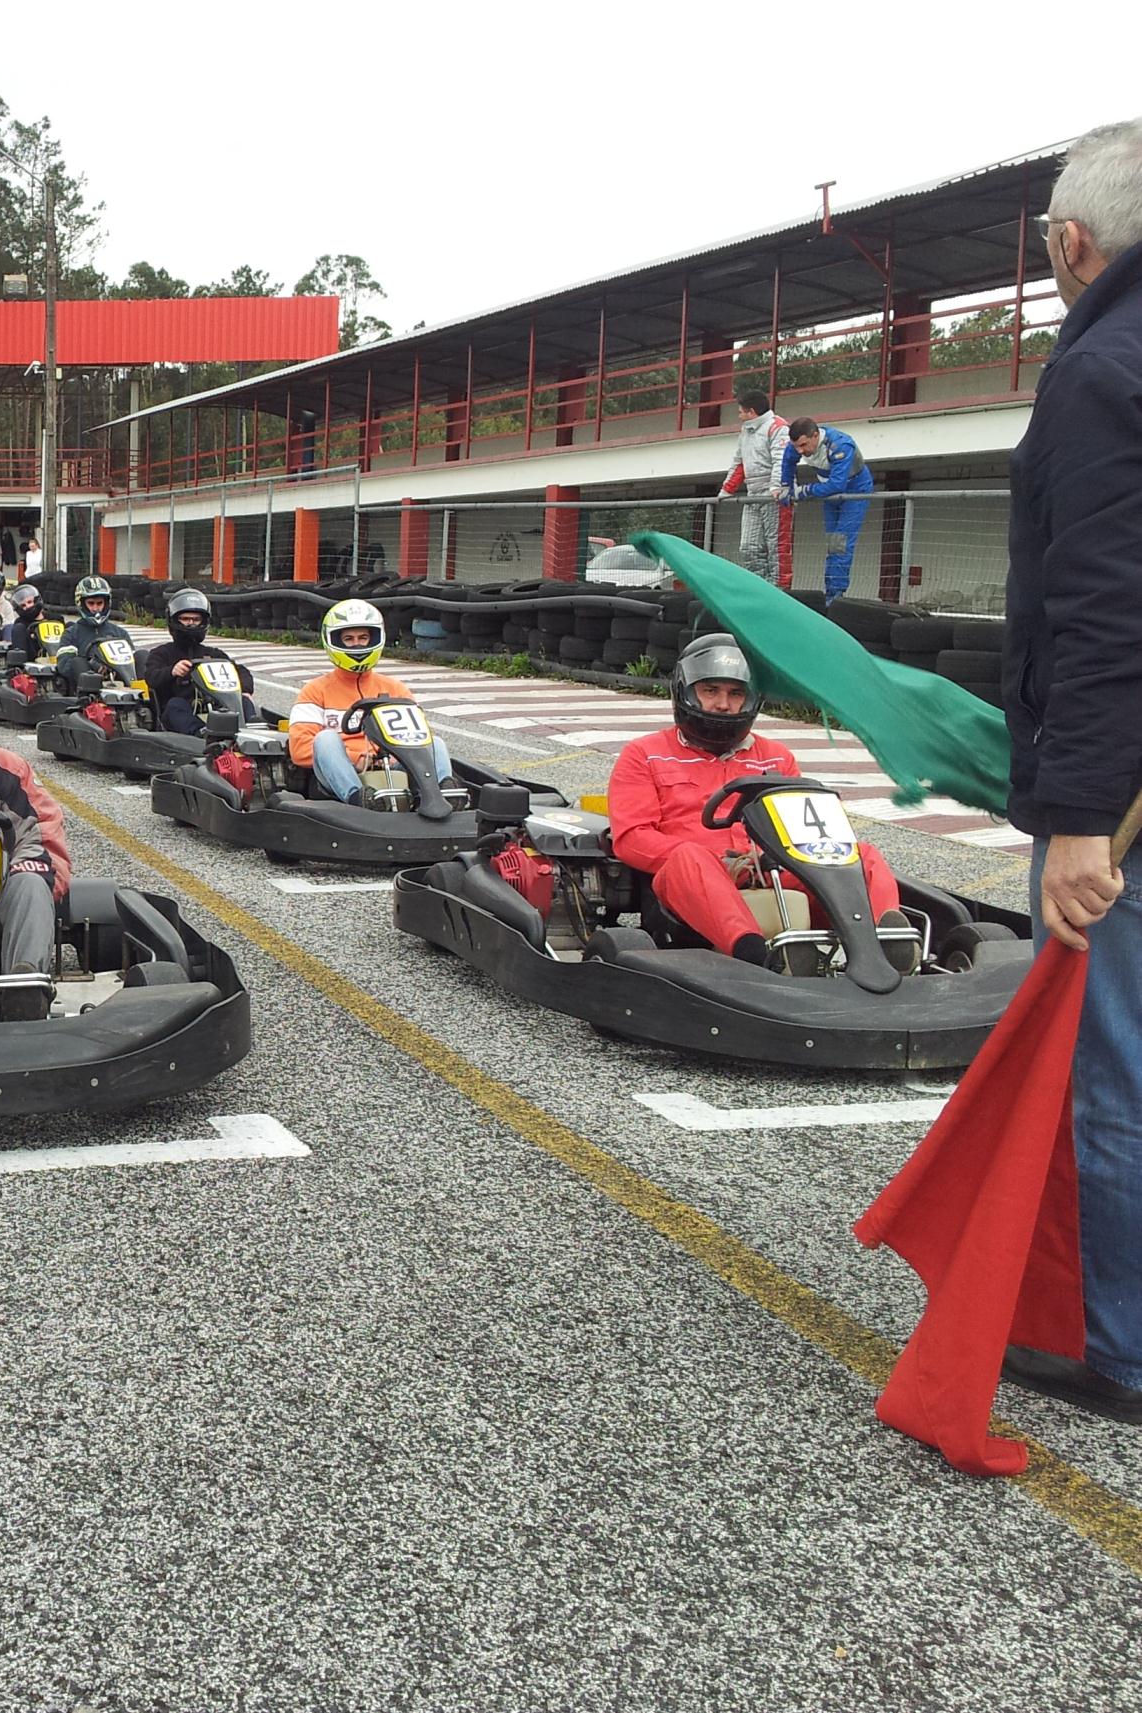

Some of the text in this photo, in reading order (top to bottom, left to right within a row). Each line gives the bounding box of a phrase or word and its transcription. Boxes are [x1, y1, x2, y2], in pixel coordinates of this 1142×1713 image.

[46, 624, 61, 635] 16
[108, 641, 129, 656] 12
[207, 664, 229, 681] 14
[382, 707, 421, 731] 21
[804, 797, 832, 839] 4
